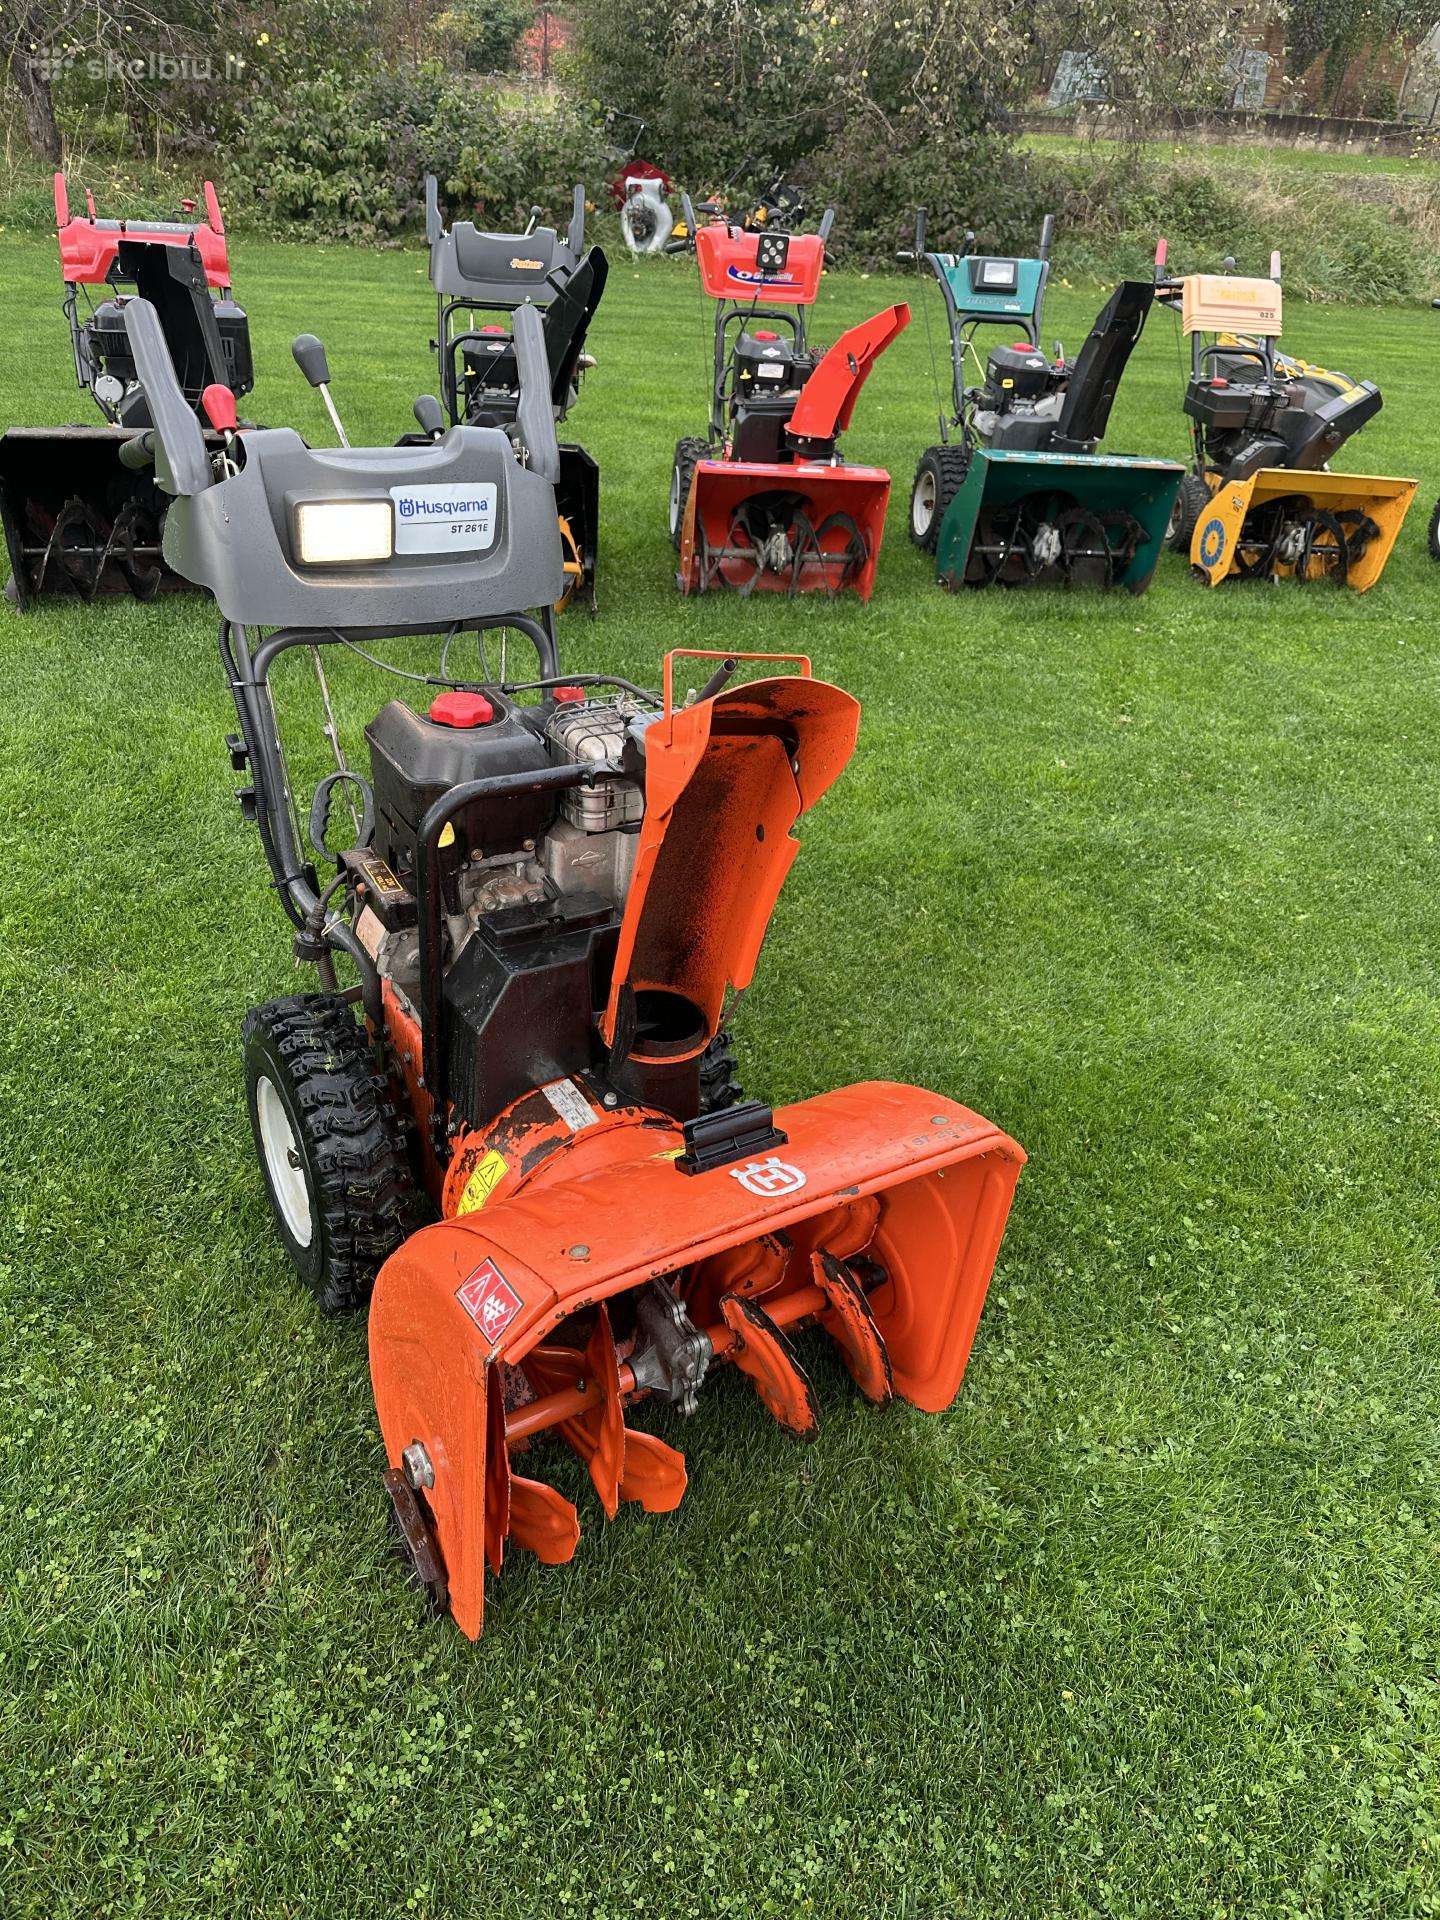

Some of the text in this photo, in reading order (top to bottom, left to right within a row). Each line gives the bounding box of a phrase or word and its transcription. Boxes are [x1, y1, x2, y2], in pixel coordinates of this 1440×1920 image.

[415, 499, 488, 515] Husqvarna
[451, 524, 488, 533] ST 261E
